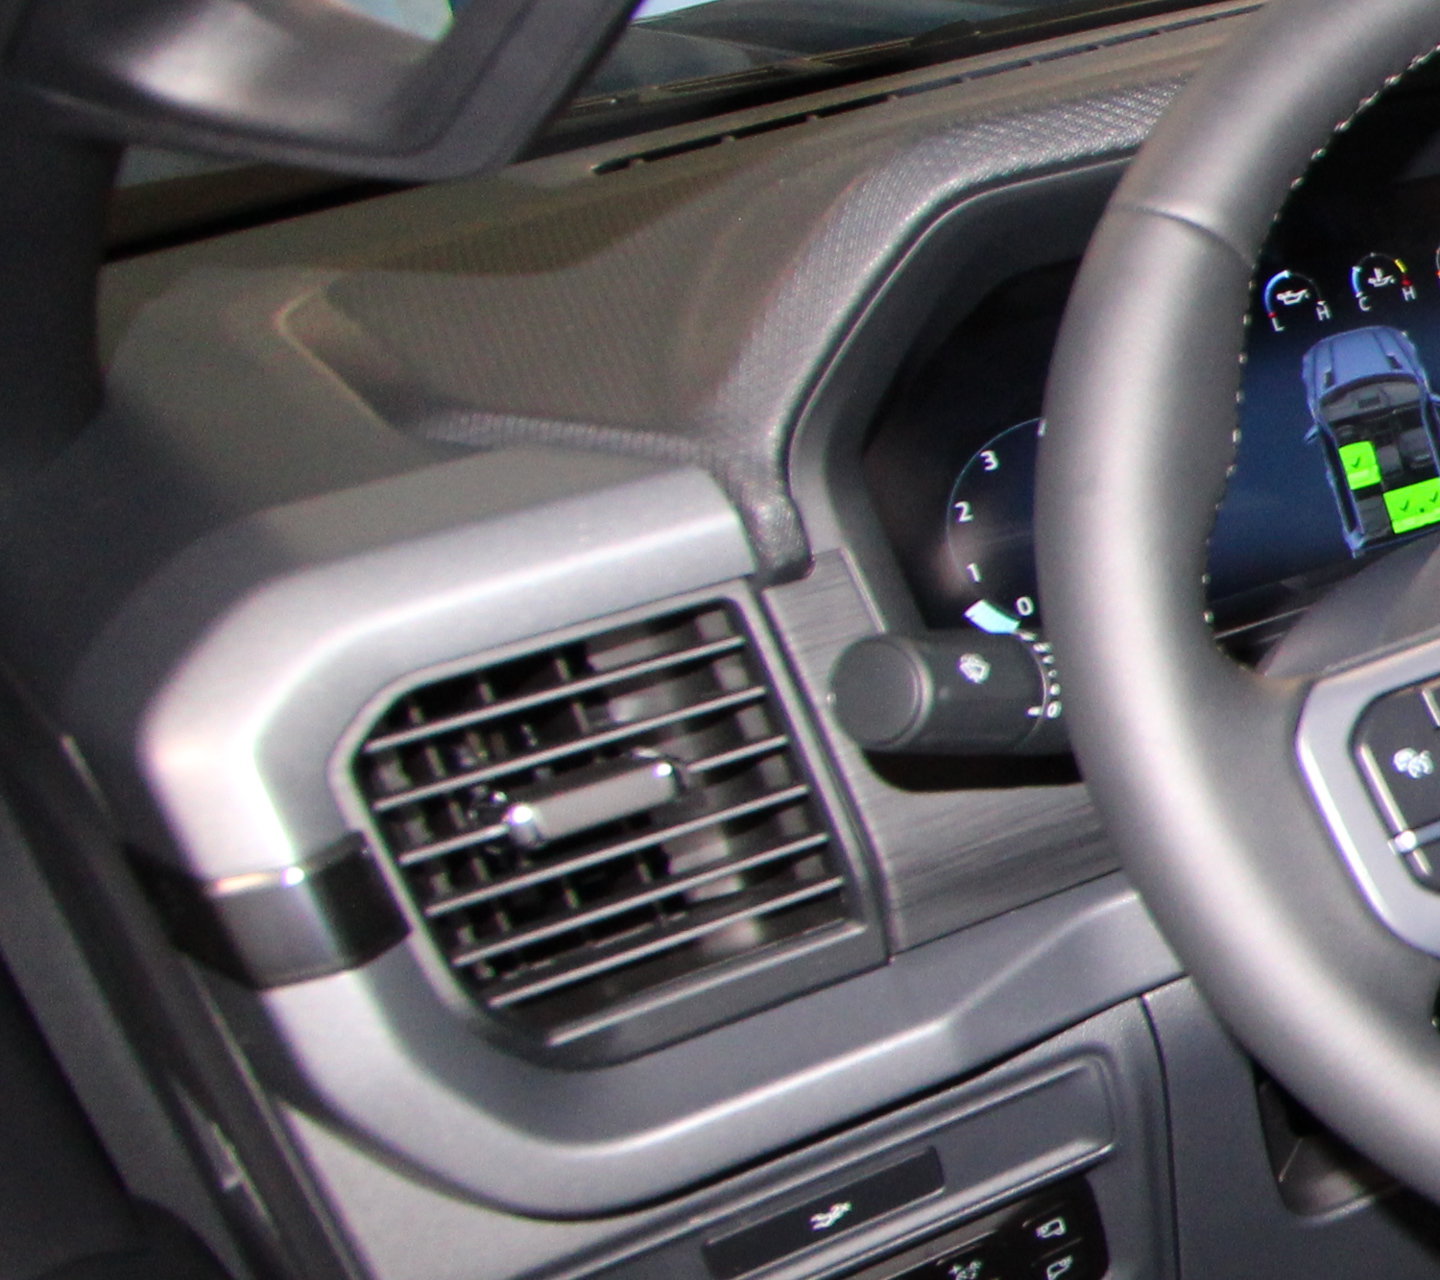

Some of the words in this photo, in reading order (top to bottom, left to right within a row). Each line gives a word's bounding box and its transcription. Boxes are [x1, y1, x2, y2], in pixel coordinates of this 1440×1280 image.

[1402, 285, 1417, 301] H
[1317, 304, 1331, 321] H
[1358, 296, 1371, 312] C
[1271, 317, 1285, 332] L
[979, 450, 1000, 472] 3
[954, 501, 974, 522] 2
[967, 563, 981, 582] 1
[1016, 597, 1034, 616] 0
